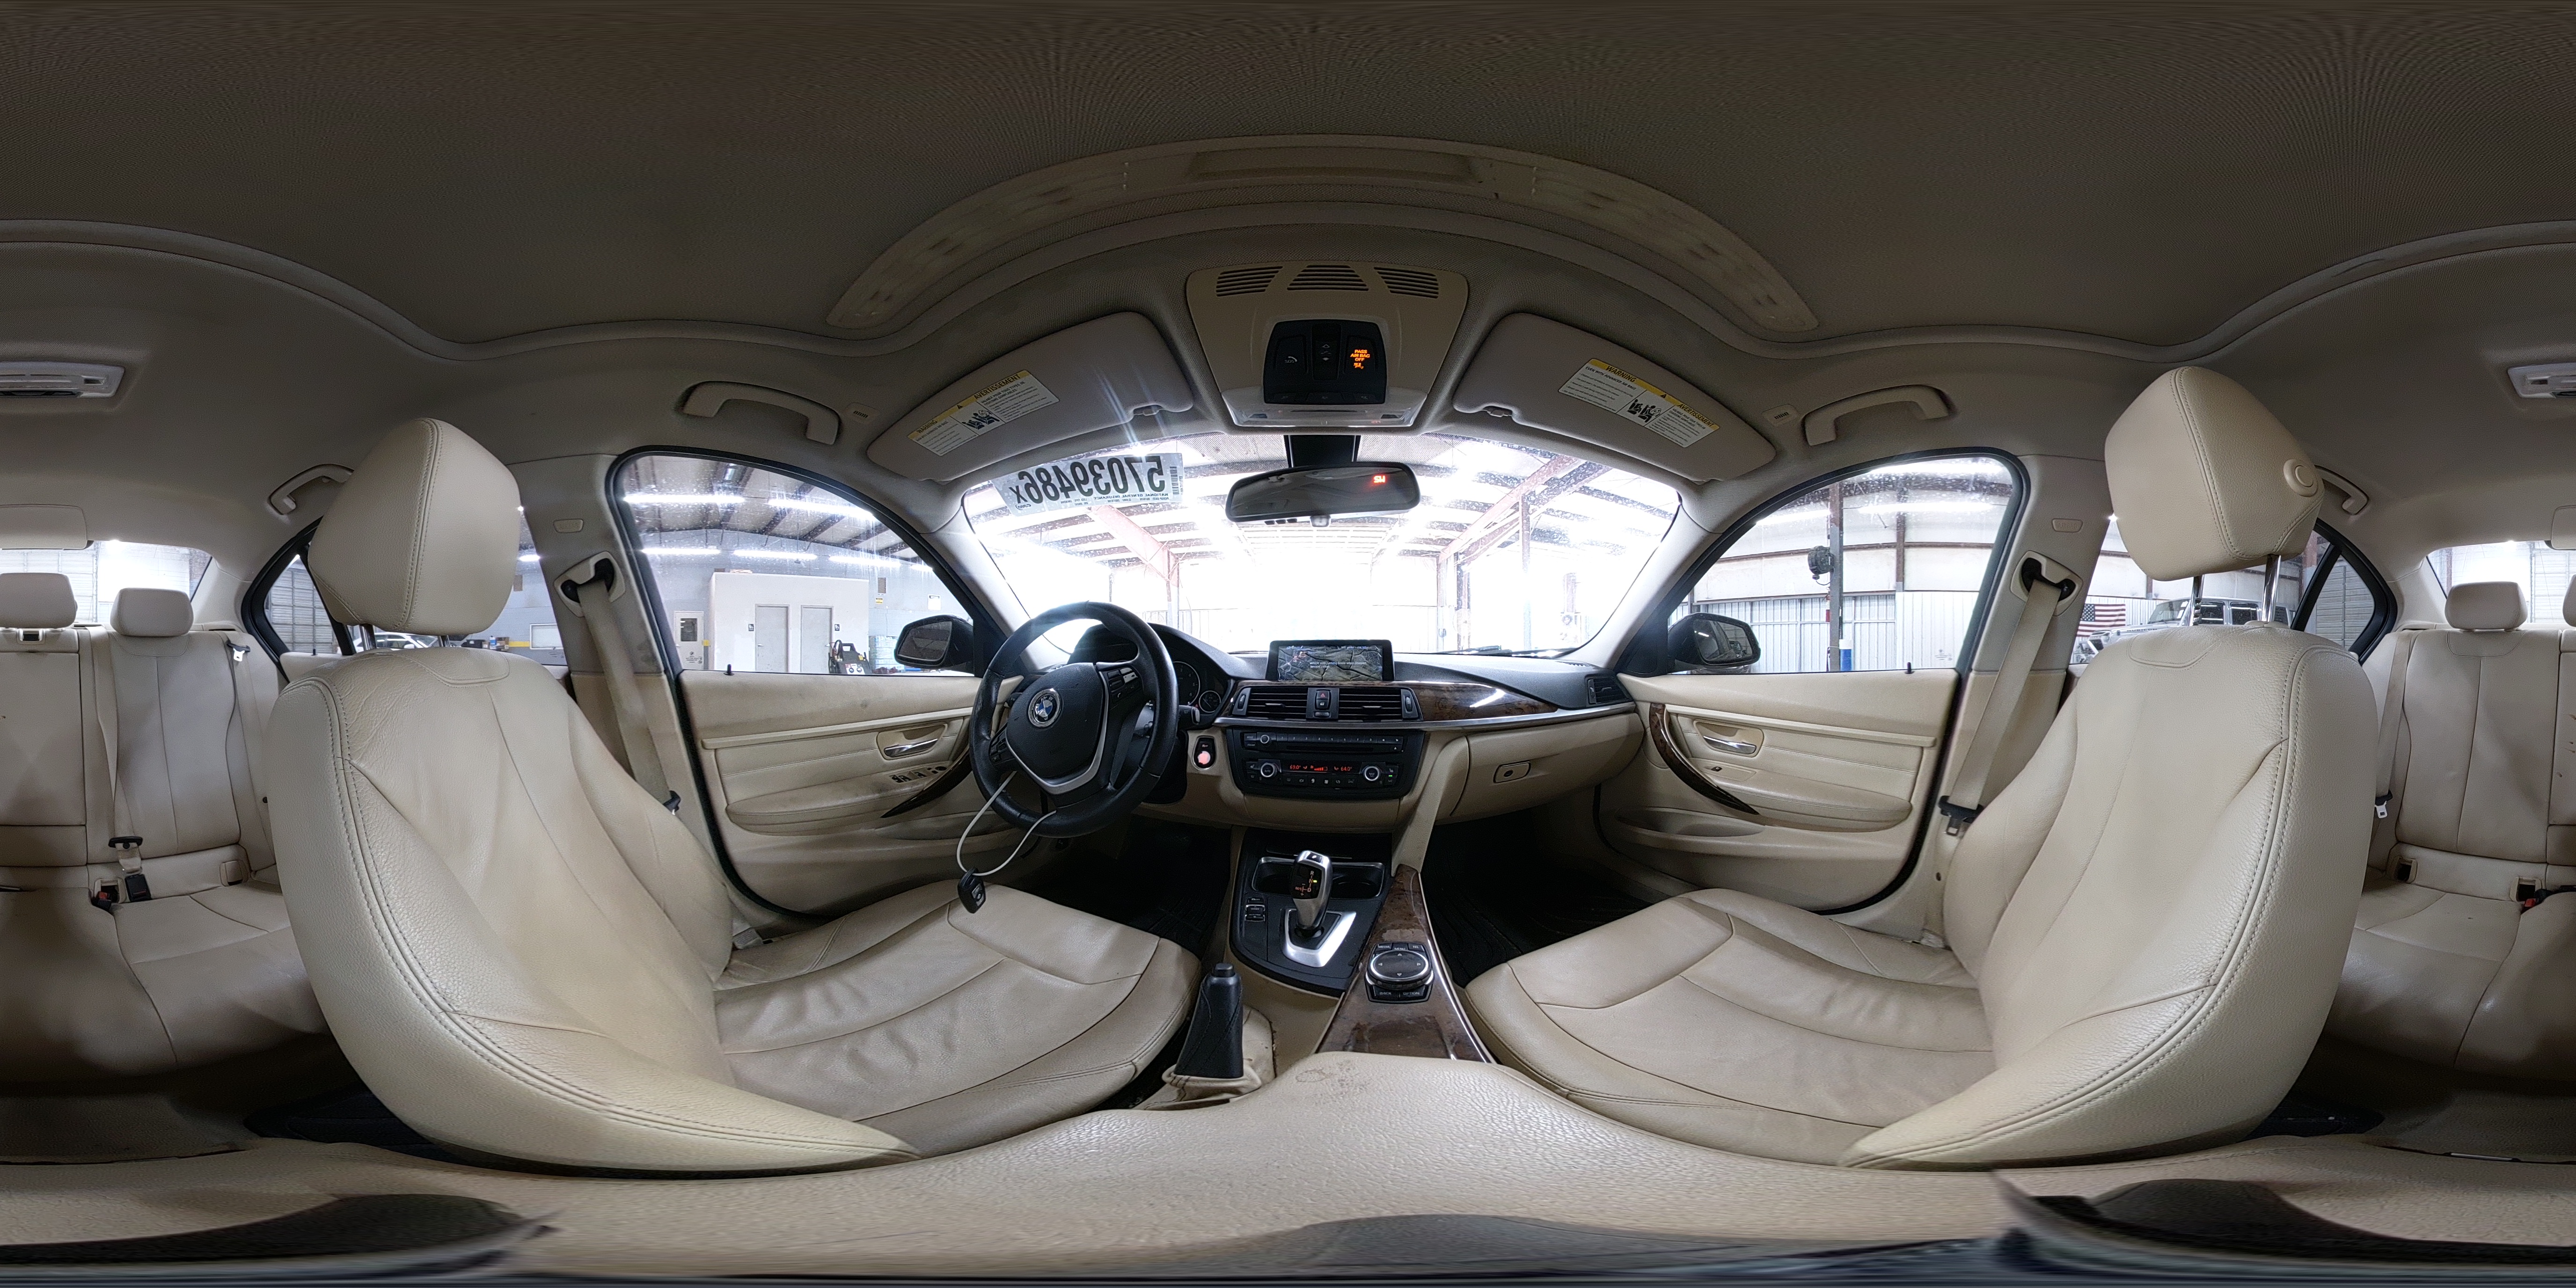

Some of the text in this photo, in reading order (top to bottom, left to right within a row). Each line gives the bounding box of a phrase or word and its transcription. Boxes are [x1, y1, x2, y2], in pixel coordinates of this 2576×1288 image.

[1606, 366, 1637, 382] WARNING
[973, 374, 1021, 399] AVERTISSEMENT
[1677, 404, 1715, 427] AVERTISSEMENT
[916, 420, 937, 433] WARNING
